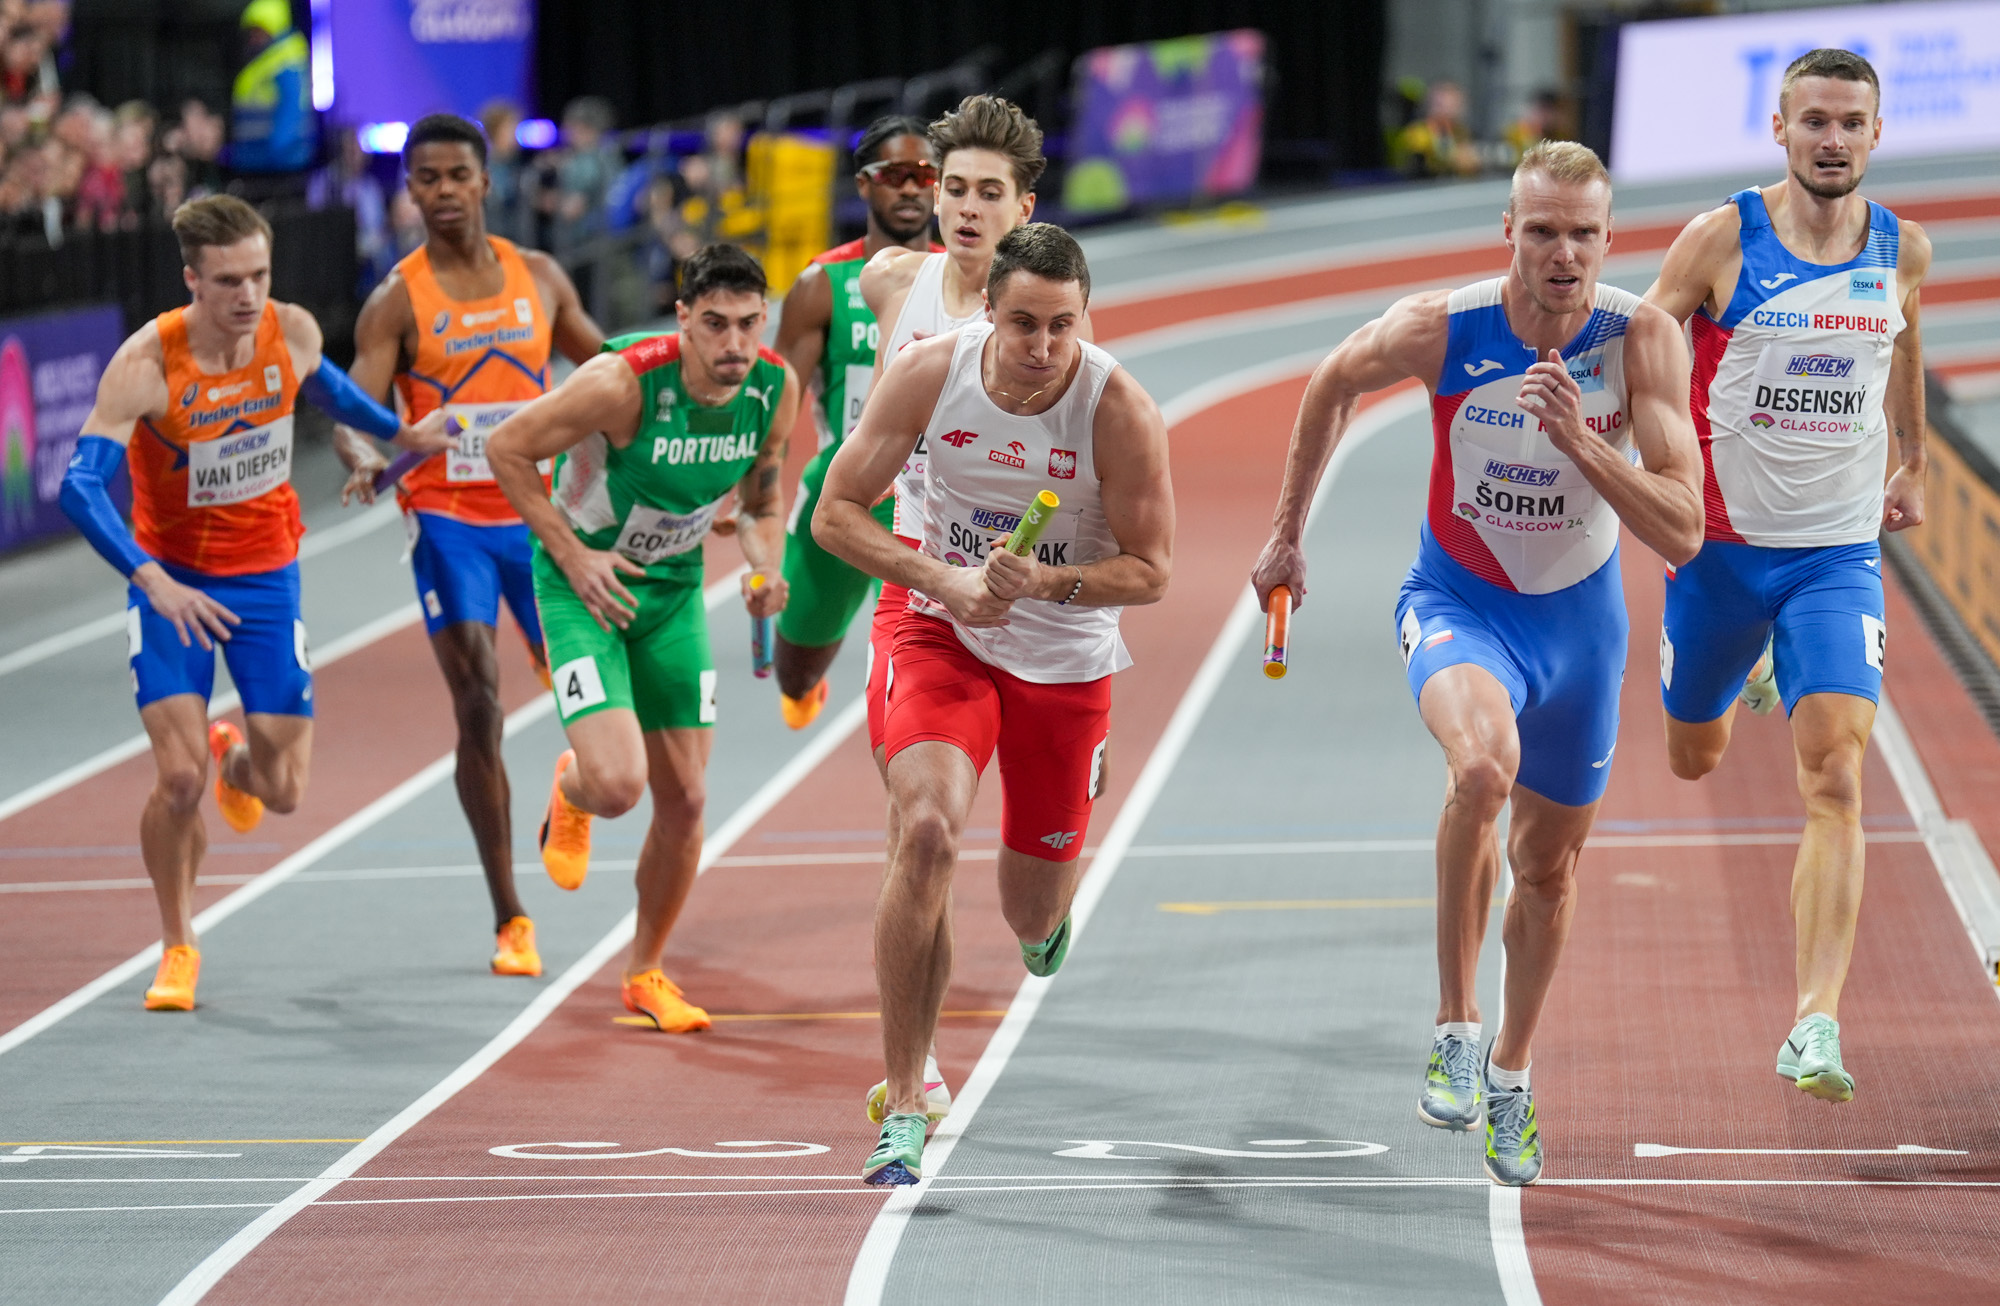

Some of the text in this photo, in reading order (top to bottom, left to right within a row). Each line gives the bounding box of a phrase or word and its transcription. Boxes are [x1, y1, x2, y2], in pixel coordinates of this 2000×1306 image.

[1753, 311, 1888, 334] CZECH REPUBLIC
[1568, 366, 1592, 380] ESKÁ
[1785, 354, 1855, 378] HI-CHEW
[1755, 384, 1867, 415] DESENSKÝ
[1465, 405, 1525, 429] CZECH
[1780, 418, 1864, 433] GLASGOW 24
[651, 431, 759, 465] PORTUGAL
[941, 429, 979, 449] 4F
[195, 445, 288, 488] VAN DIEPEN
[990, 452, 1024, 469] ORLEN
[1483, 458, 1560, 487] HI-CHEW
[1475, 480, 1565, 517] ŠORM
[1485, 514, 1584, 532] GLASGOW 24
[567, 670, 584, 701] 4
[1040, 831, 1079, 850] 4F
